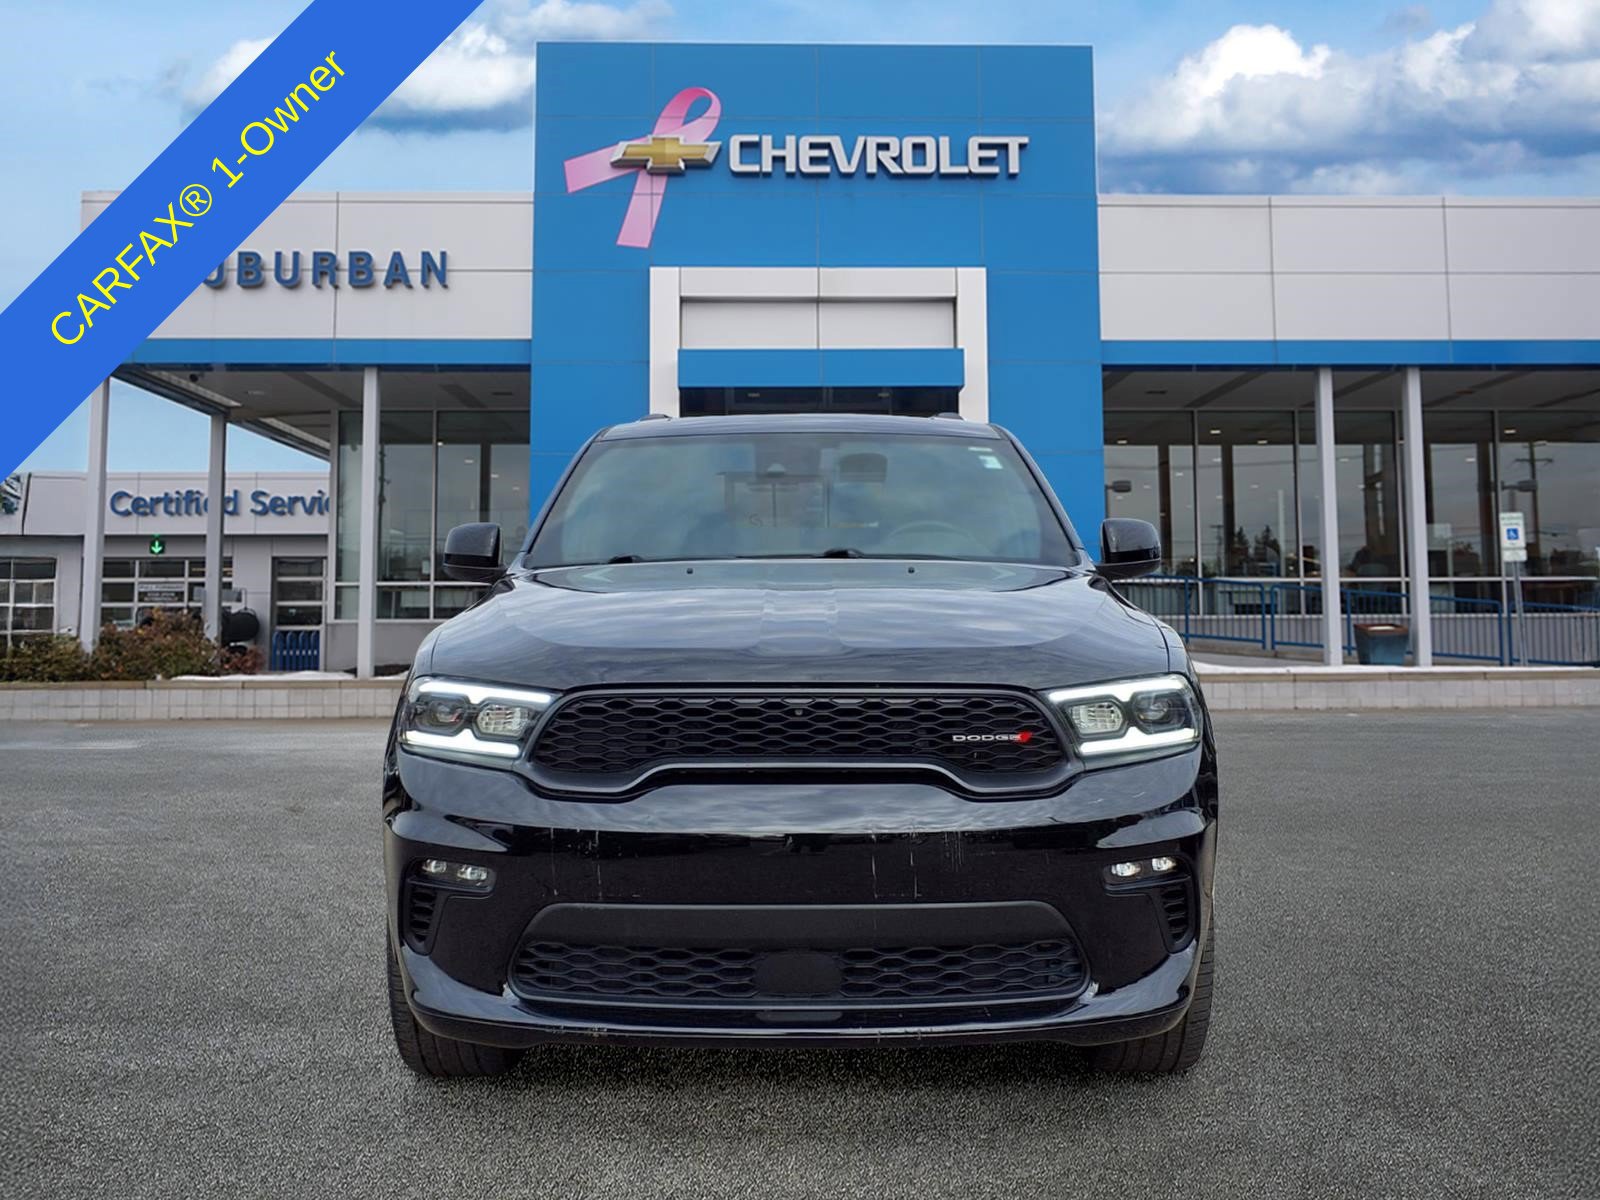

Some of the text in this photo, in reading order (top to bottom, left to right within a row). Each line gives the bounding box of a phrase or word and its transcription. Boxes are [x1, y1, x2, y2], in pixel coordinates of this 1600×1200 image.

[728, 134, 1029, 174] CHEVROLET
[110, 489, 330, 516] Certifid Servi
[952, 734, 1019, 742] DODGE
